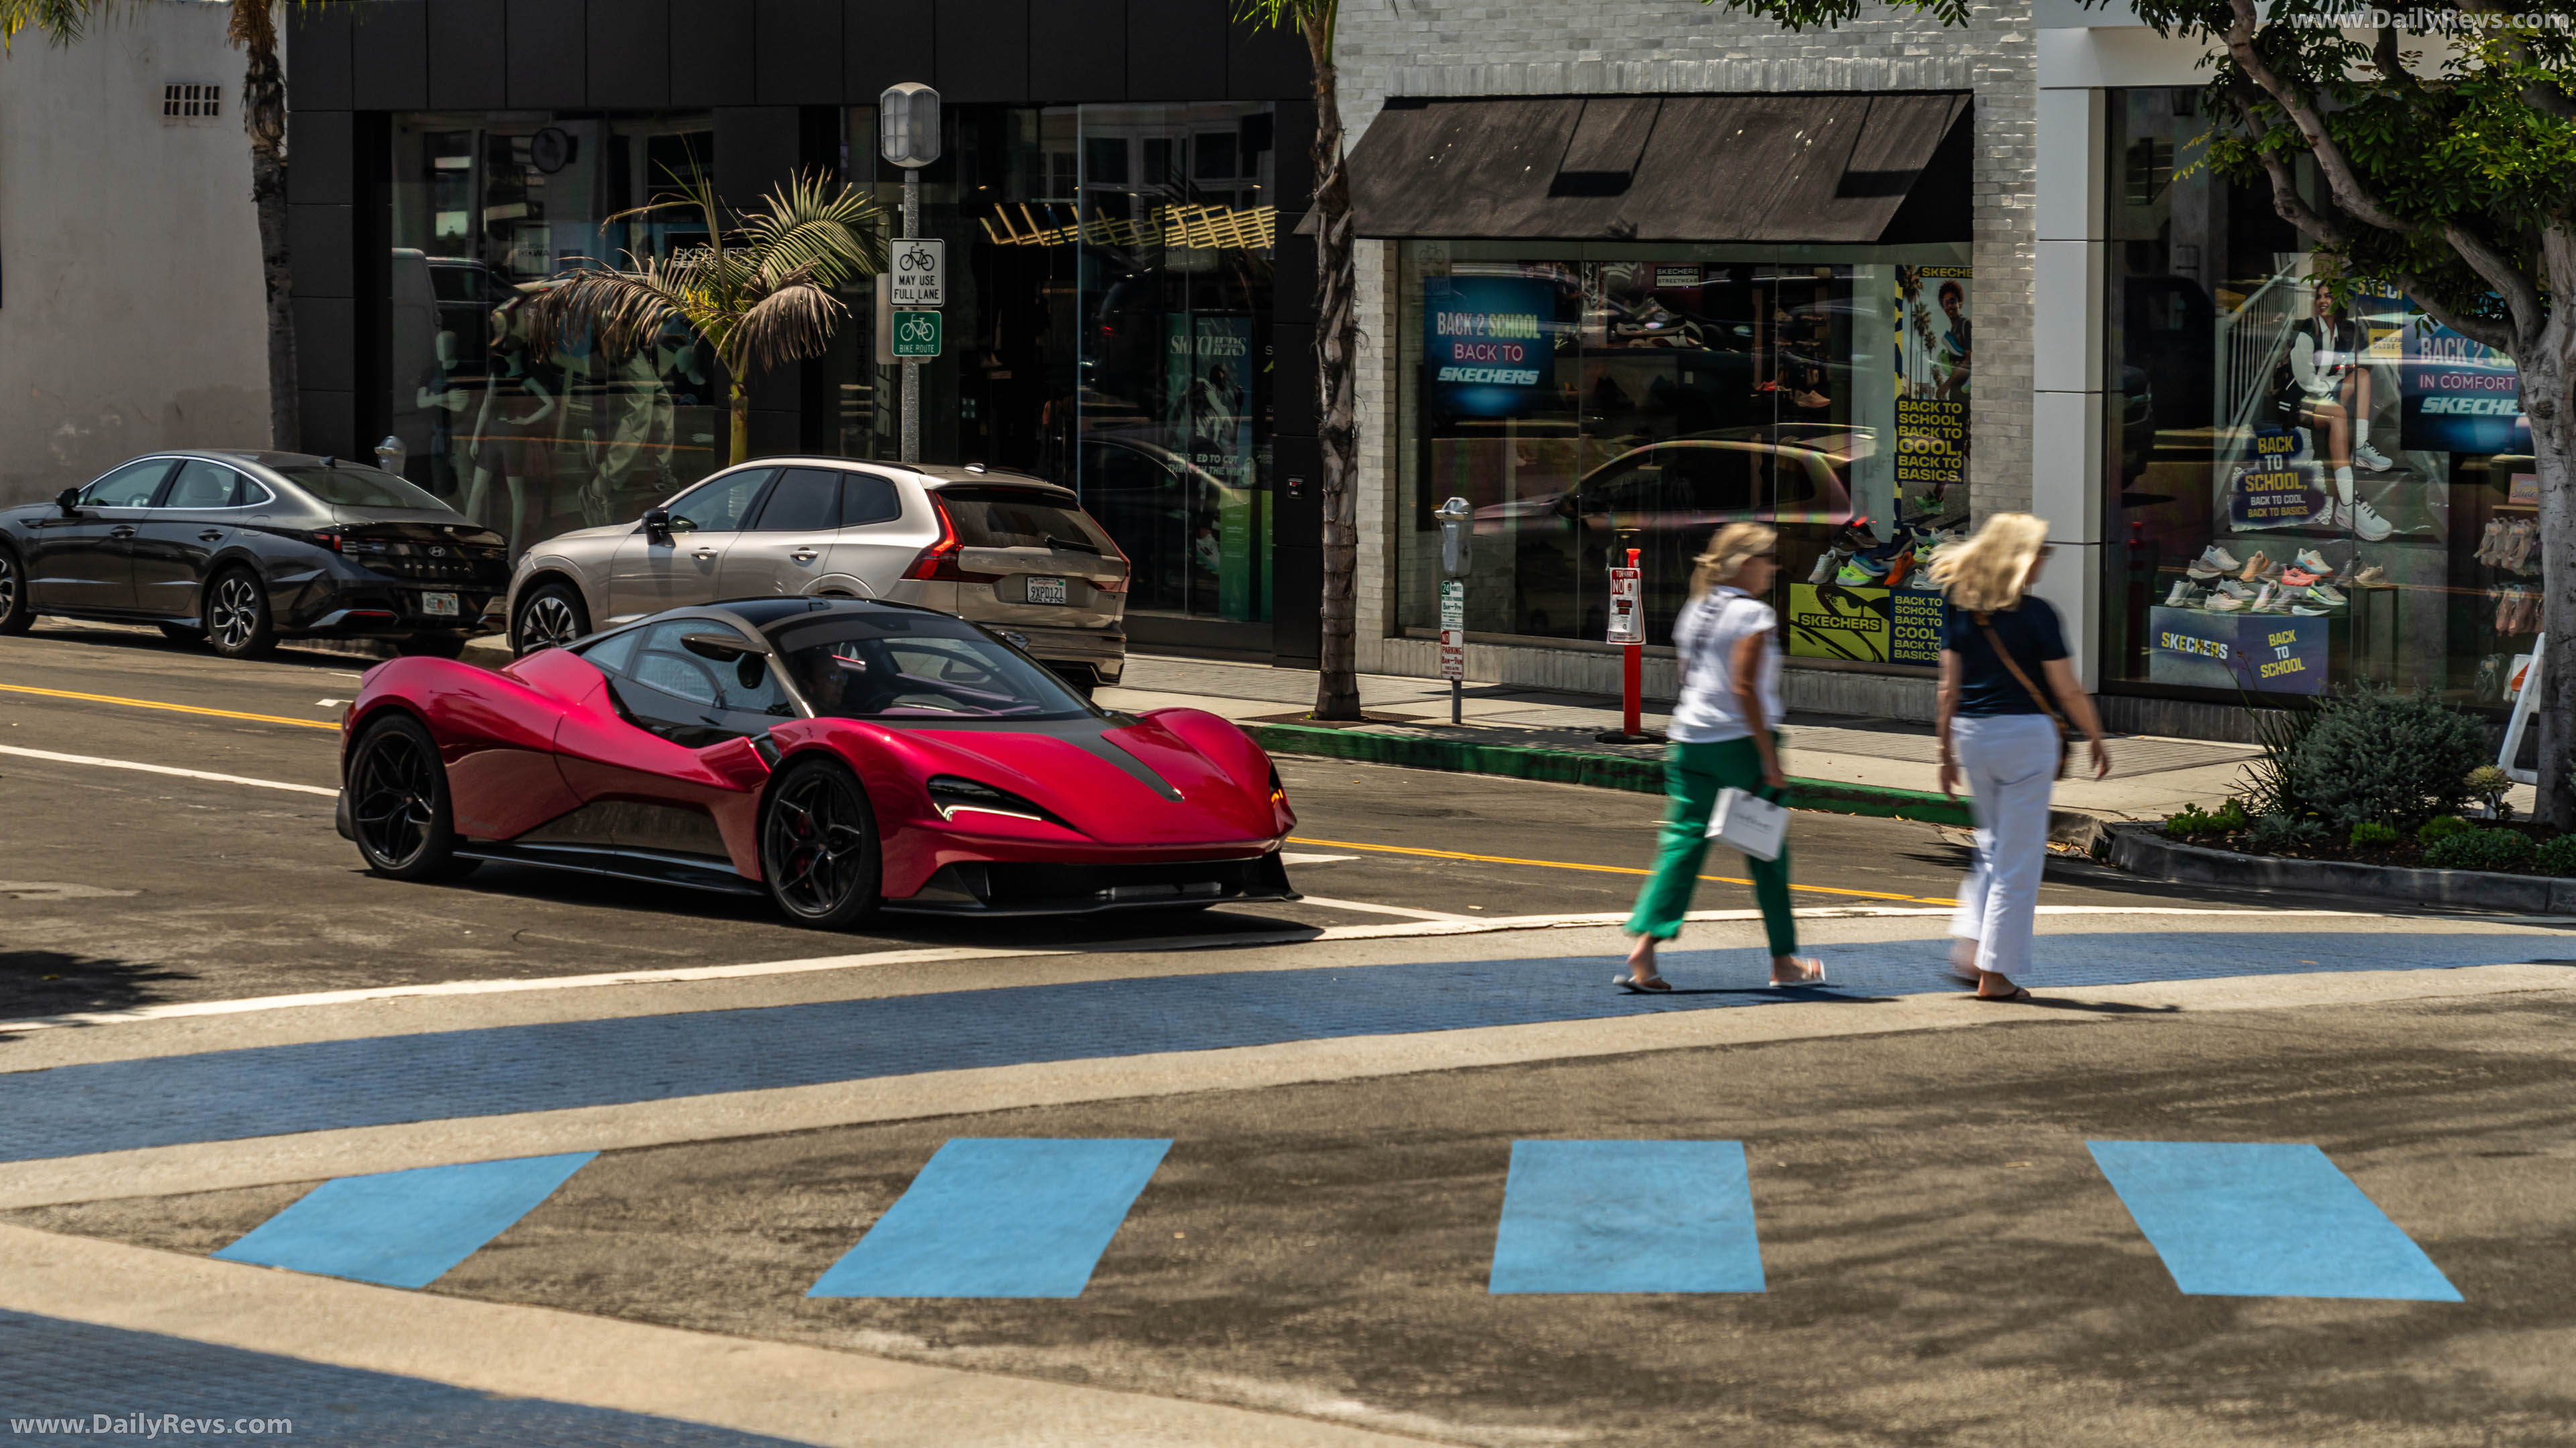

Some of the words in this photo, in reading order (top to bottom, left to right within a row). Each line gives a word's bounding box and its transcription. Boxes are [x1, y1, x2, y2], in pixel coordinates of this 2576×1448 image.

[899, 275, 915, 286] MAY
[920, 276, 935, 286] USE
[894, 289, 913, 299] FULL
[918, 289, 940, 299] LANE
[1437, 311, 1473, 335] BACK
[1477, 313, 1485, 336] 2
[1488, 313, 1542, 339] SCHOOL
[900, 344, 913, 353] BIKE
[916, 344, 934, 353] ROUTE
[1170, 335, 1246, 356] SKCHERS
[1453, 343, 1498, 361] BACK
[1502, 345, 1523, 361] TO
[2420, 337, 2468, 364] BACK
[2473, 341, 2485, 365] 2
[1438, 366, 1540, 385] SKECHERS
[2420, 374, 2435, 388] IN
[2440, 375, 2516, 390] COMFORT
[1898, 400, 1940, 412] BACK
[1943, 402, 1963, 414] TO
[1898, 413, 1963, 428] SCHOOL,
[1898, 425, 1940, 438] BACK
[1943, 427, 1963, 439] TO
[1898, 438, 1962, 458] COOL,
[2258, 435, 2294, 454] BACK
[1167, 453, 1208, 463] DESIGED
[1210, 453, 1221, 463] TO
[1222, 455, 1239, 464] CUT
[1898, 455, 1940, 468] BACK
[1943, 457, 1962, 469] TO
[2265, 454, 2283, 471] TO
[1209, 466, 1225, 476] THE
[1898, 468, 1962, 482] BASICS.
[2245, 471, 2308, 492] SCHOOL,
[2251, 496, 2271, 506] BACK
[2272, 495, 2282, 504] TO
[2248, 508, 2268, 518] BACK
[2269, 507, 2279, 516] TO
[404, 563, 473, 573] SONATA
[1031, 586, 1063, 599] 9XPD121
[1442, 583, 1450, 594] 24
[1613, 579, 1624, 593] NO
[1894, 595, 1926, 606] BACK
[1927, 598, 1943, 607] TO
[1894, 606, 1943, 618] SCHOOL,
[1800, 614, 1880, 631] SKECHERS
[1894, 616, 1926, 626] BACK
[1927, 618, 1943, 627] TO
[1442, 634, 1449, 643] NO
[1894, 626, 1941, 642] COOL,
[2268, 629, 2298, 647] BACK
[1442, 646, 1462, 655] PARKING
[1894, 639, 1925, 651] BACK
[1927, 642, 1941, 651] TO
[2161, 632, 2229, 660] SKECHERS
[2275, 645, 2290, 660] TO
[2260, 657, 2306, 679] SCHOOL
